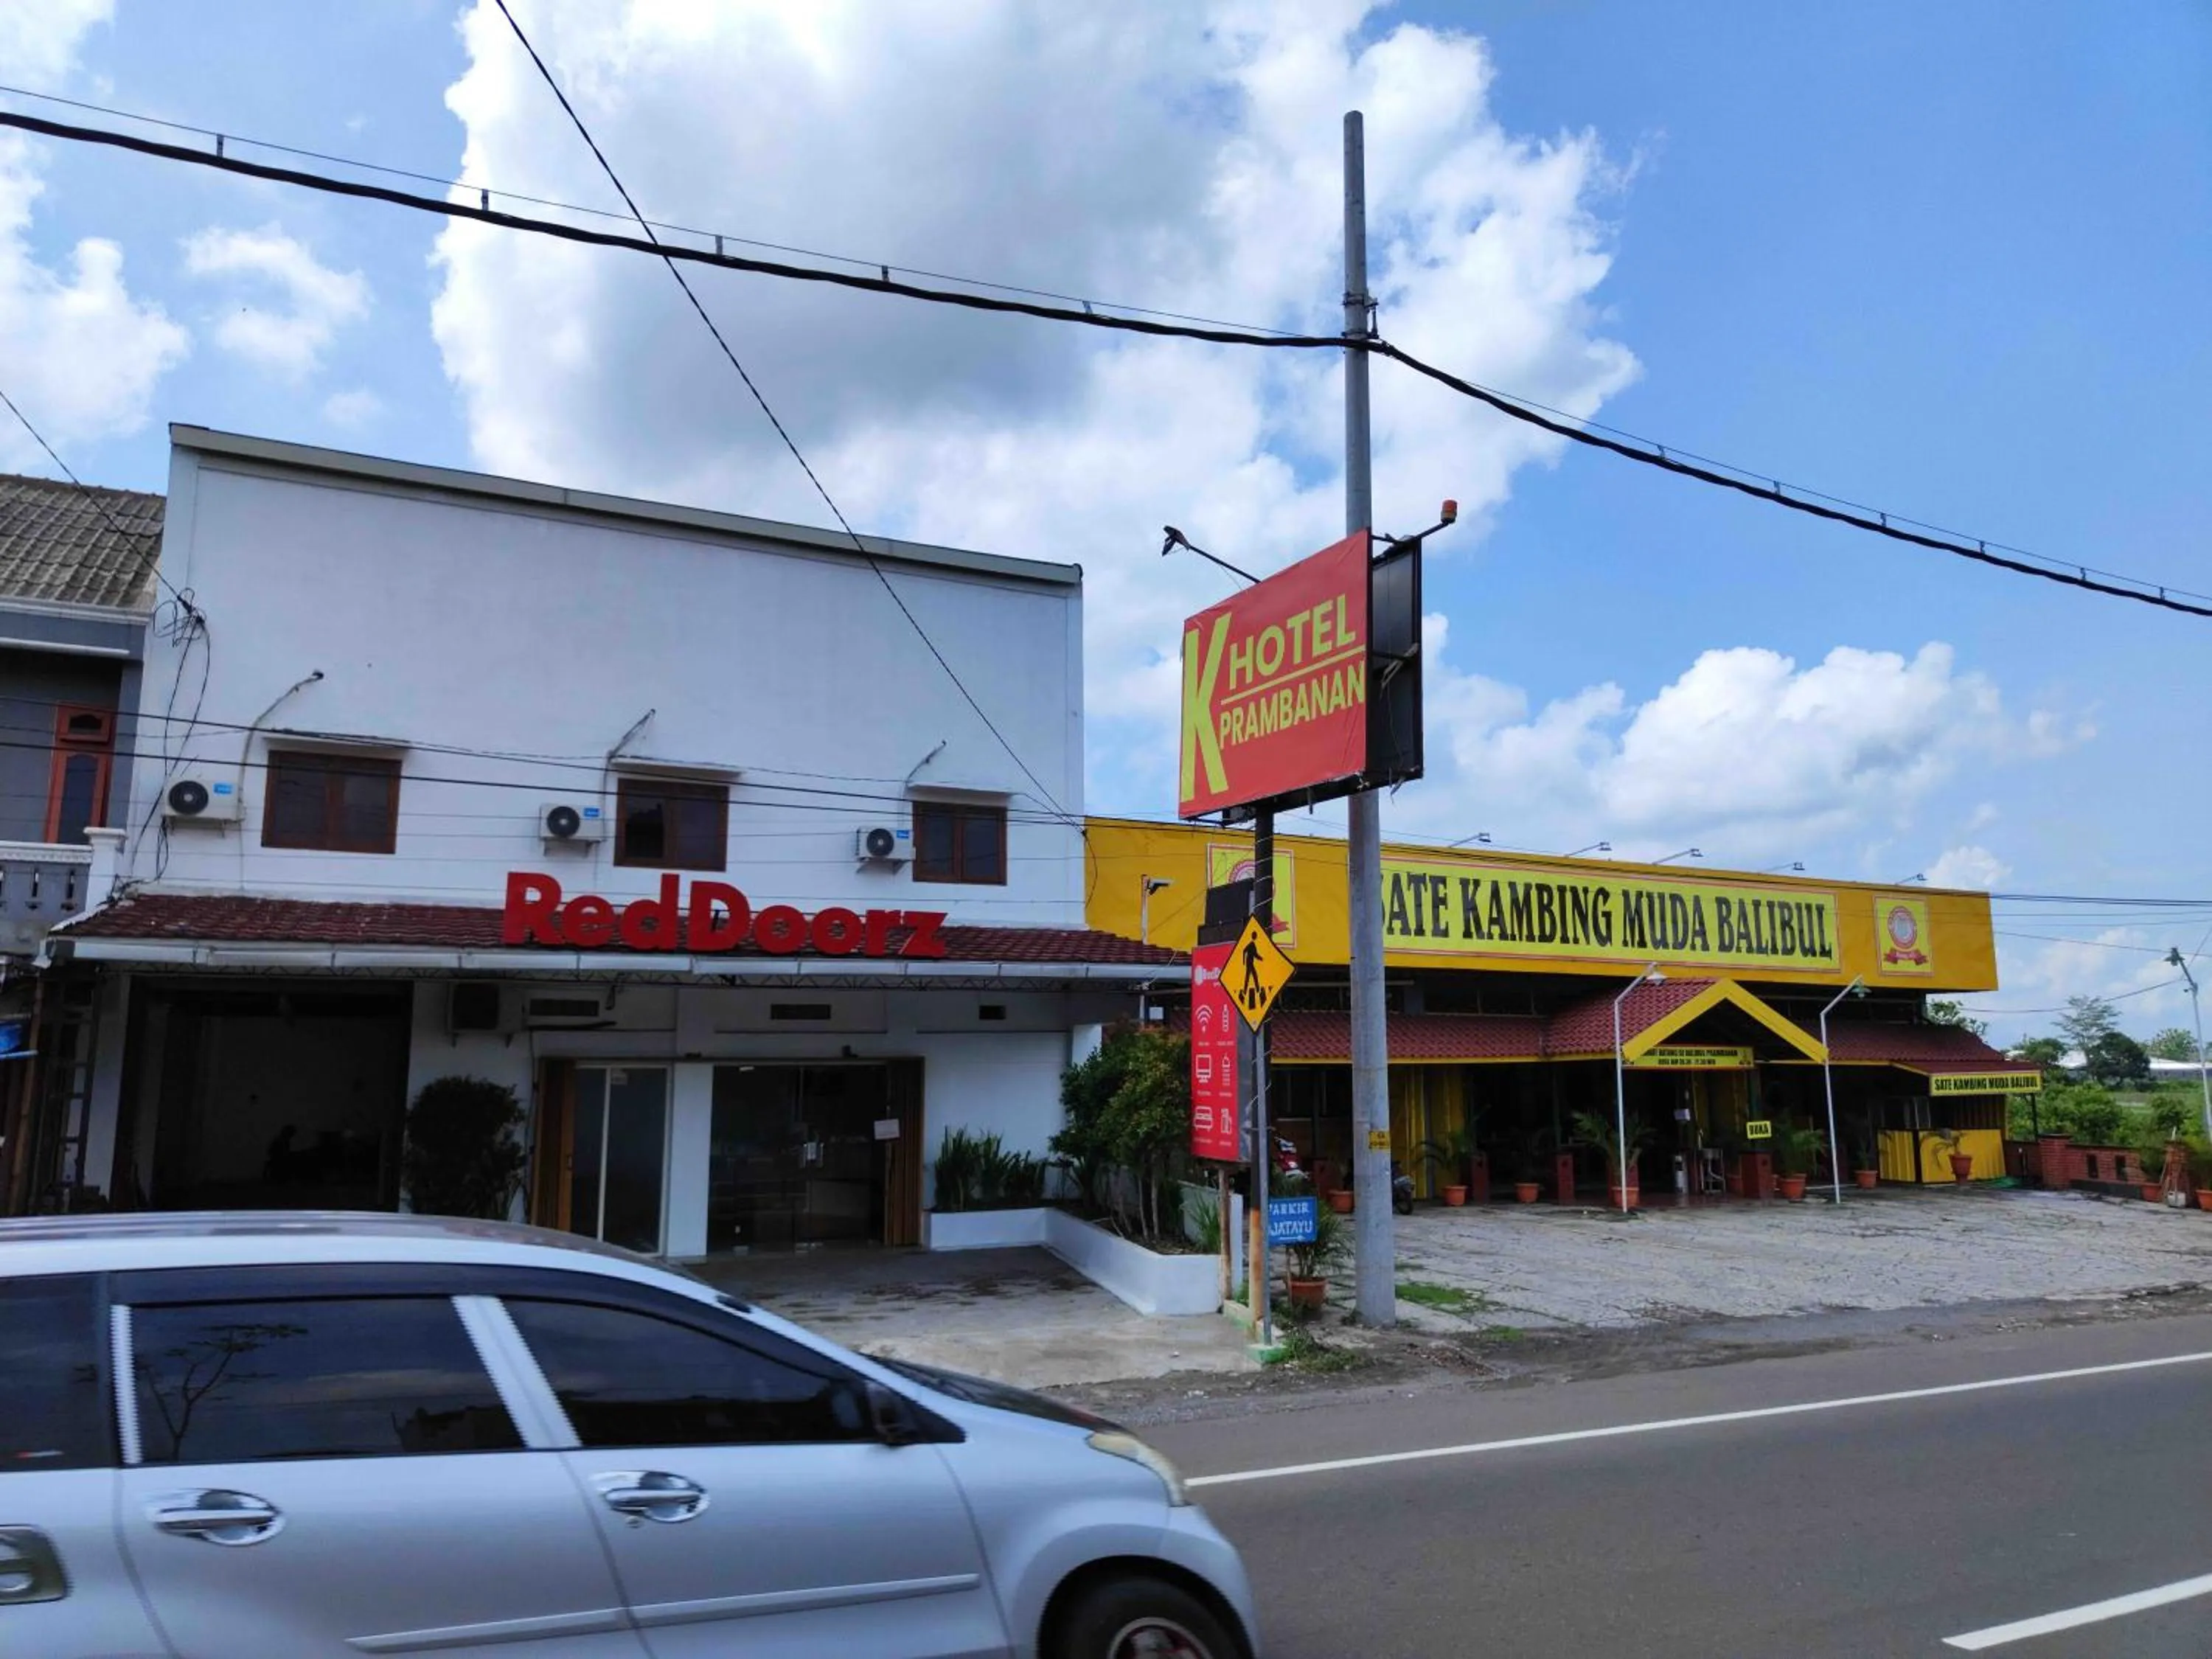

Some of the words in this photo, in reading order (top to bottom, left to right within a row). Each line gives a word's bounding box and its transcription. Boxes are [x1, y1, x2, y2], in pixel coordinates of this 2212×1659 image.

[1228, 594, 1356, 690] HOTEL
[1180, 611, 1232, 804] K
[1219, 660, 1366, 751] PRAMBANAN
[501, 871, 949, 958] RedDoorz
[1380, 871, 1450, 939] ATE
[1458, 877, 1613, 947] KAMBING
[1621, 888, 1711, 952] MUDA
[1714, 896, 1833, 961] BALIBUL
